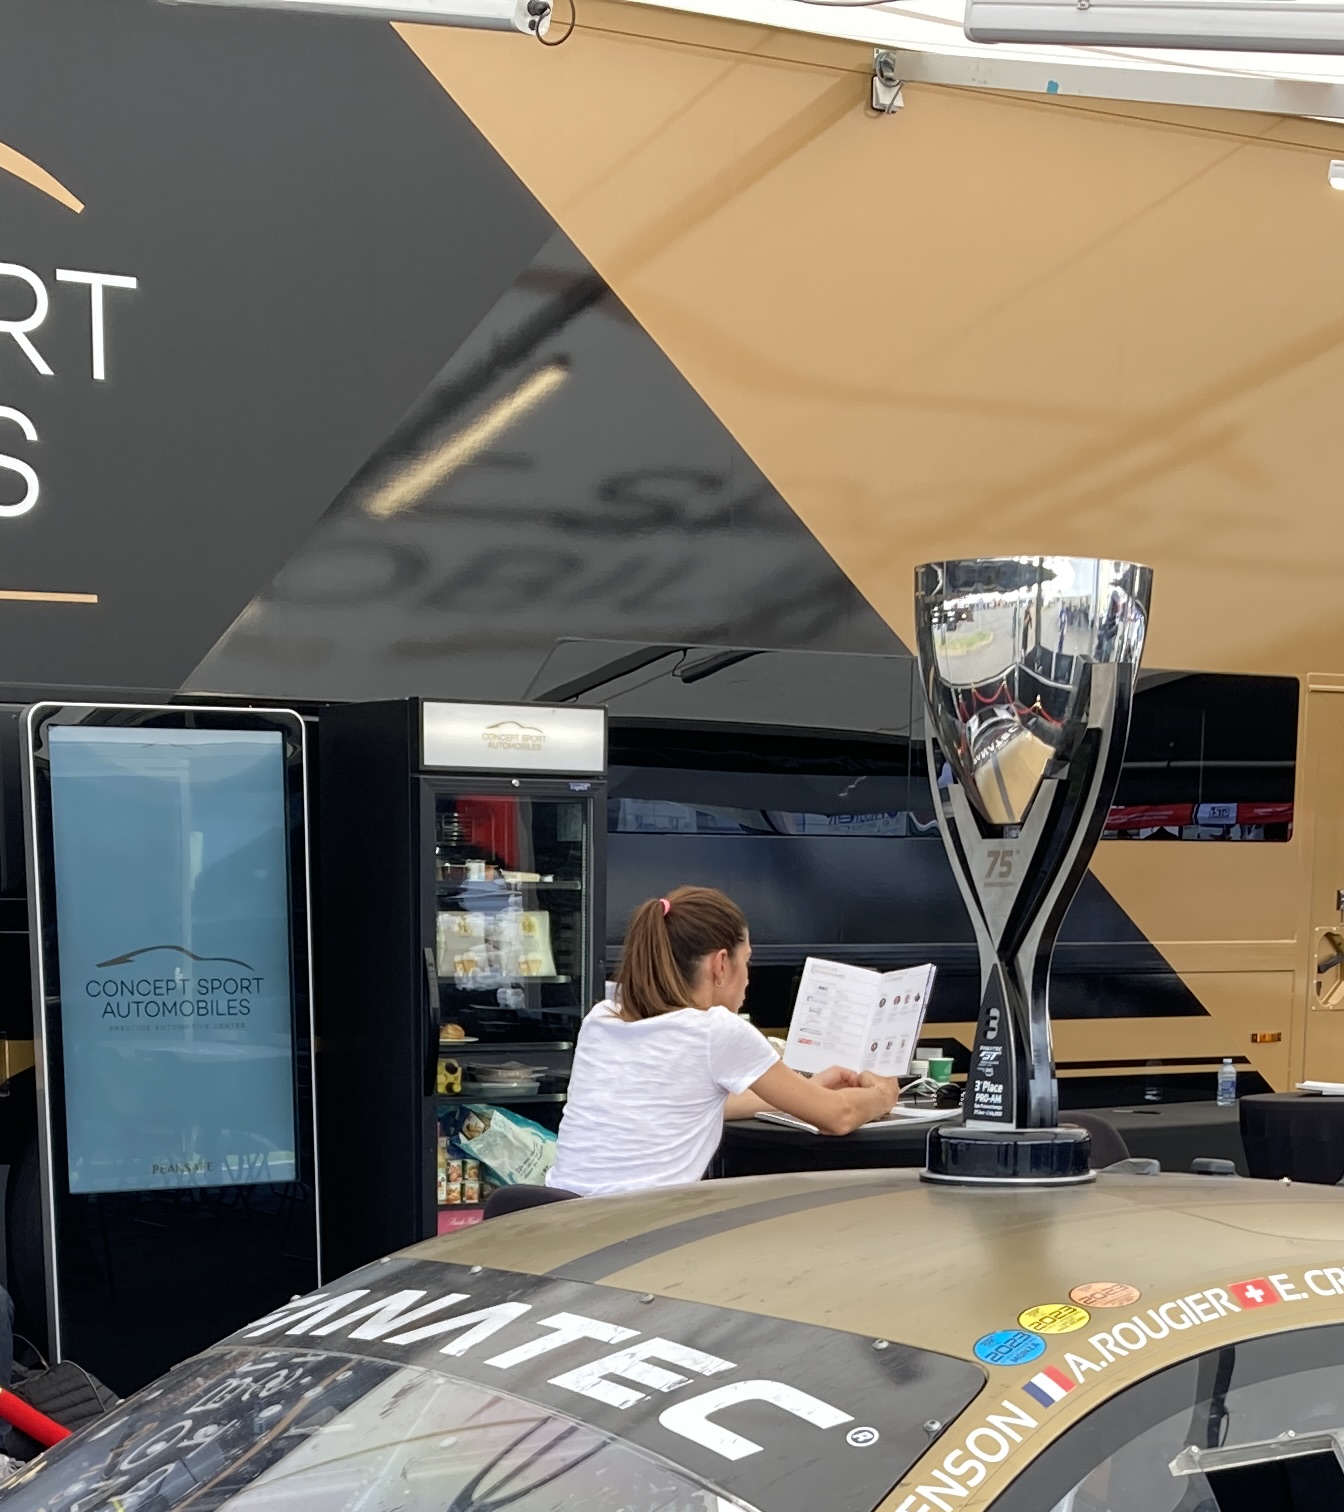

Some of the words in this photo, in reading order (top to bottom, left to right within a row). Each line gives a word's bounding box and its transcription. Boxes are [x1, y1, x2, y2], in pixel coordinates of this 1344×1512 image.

[482, 732, 519, 742] CONCEPT
[522, 734, 546, 743] SPORT
[487, 741, 542, 751] AUTOMOBILES
[984, 849, 1014, 879] 75
[85, 978, 191, 998] CONCEPT
[197, 977, 265, 996] SPORT
[101, 998, 251, 1019] AUTOMOBILES
[154, 1022, 210, 1031] AUTOMOTIVE
[213, 1021, 246, 1030] CENTER
[1078, 1282, 1130, 1305] 2023
[1027, 1305, 1077, 1331] 2023
[1063, 1286, 1239, 1384] A.ROUGIER
[984, 1331, 1032, 1363] 2023
